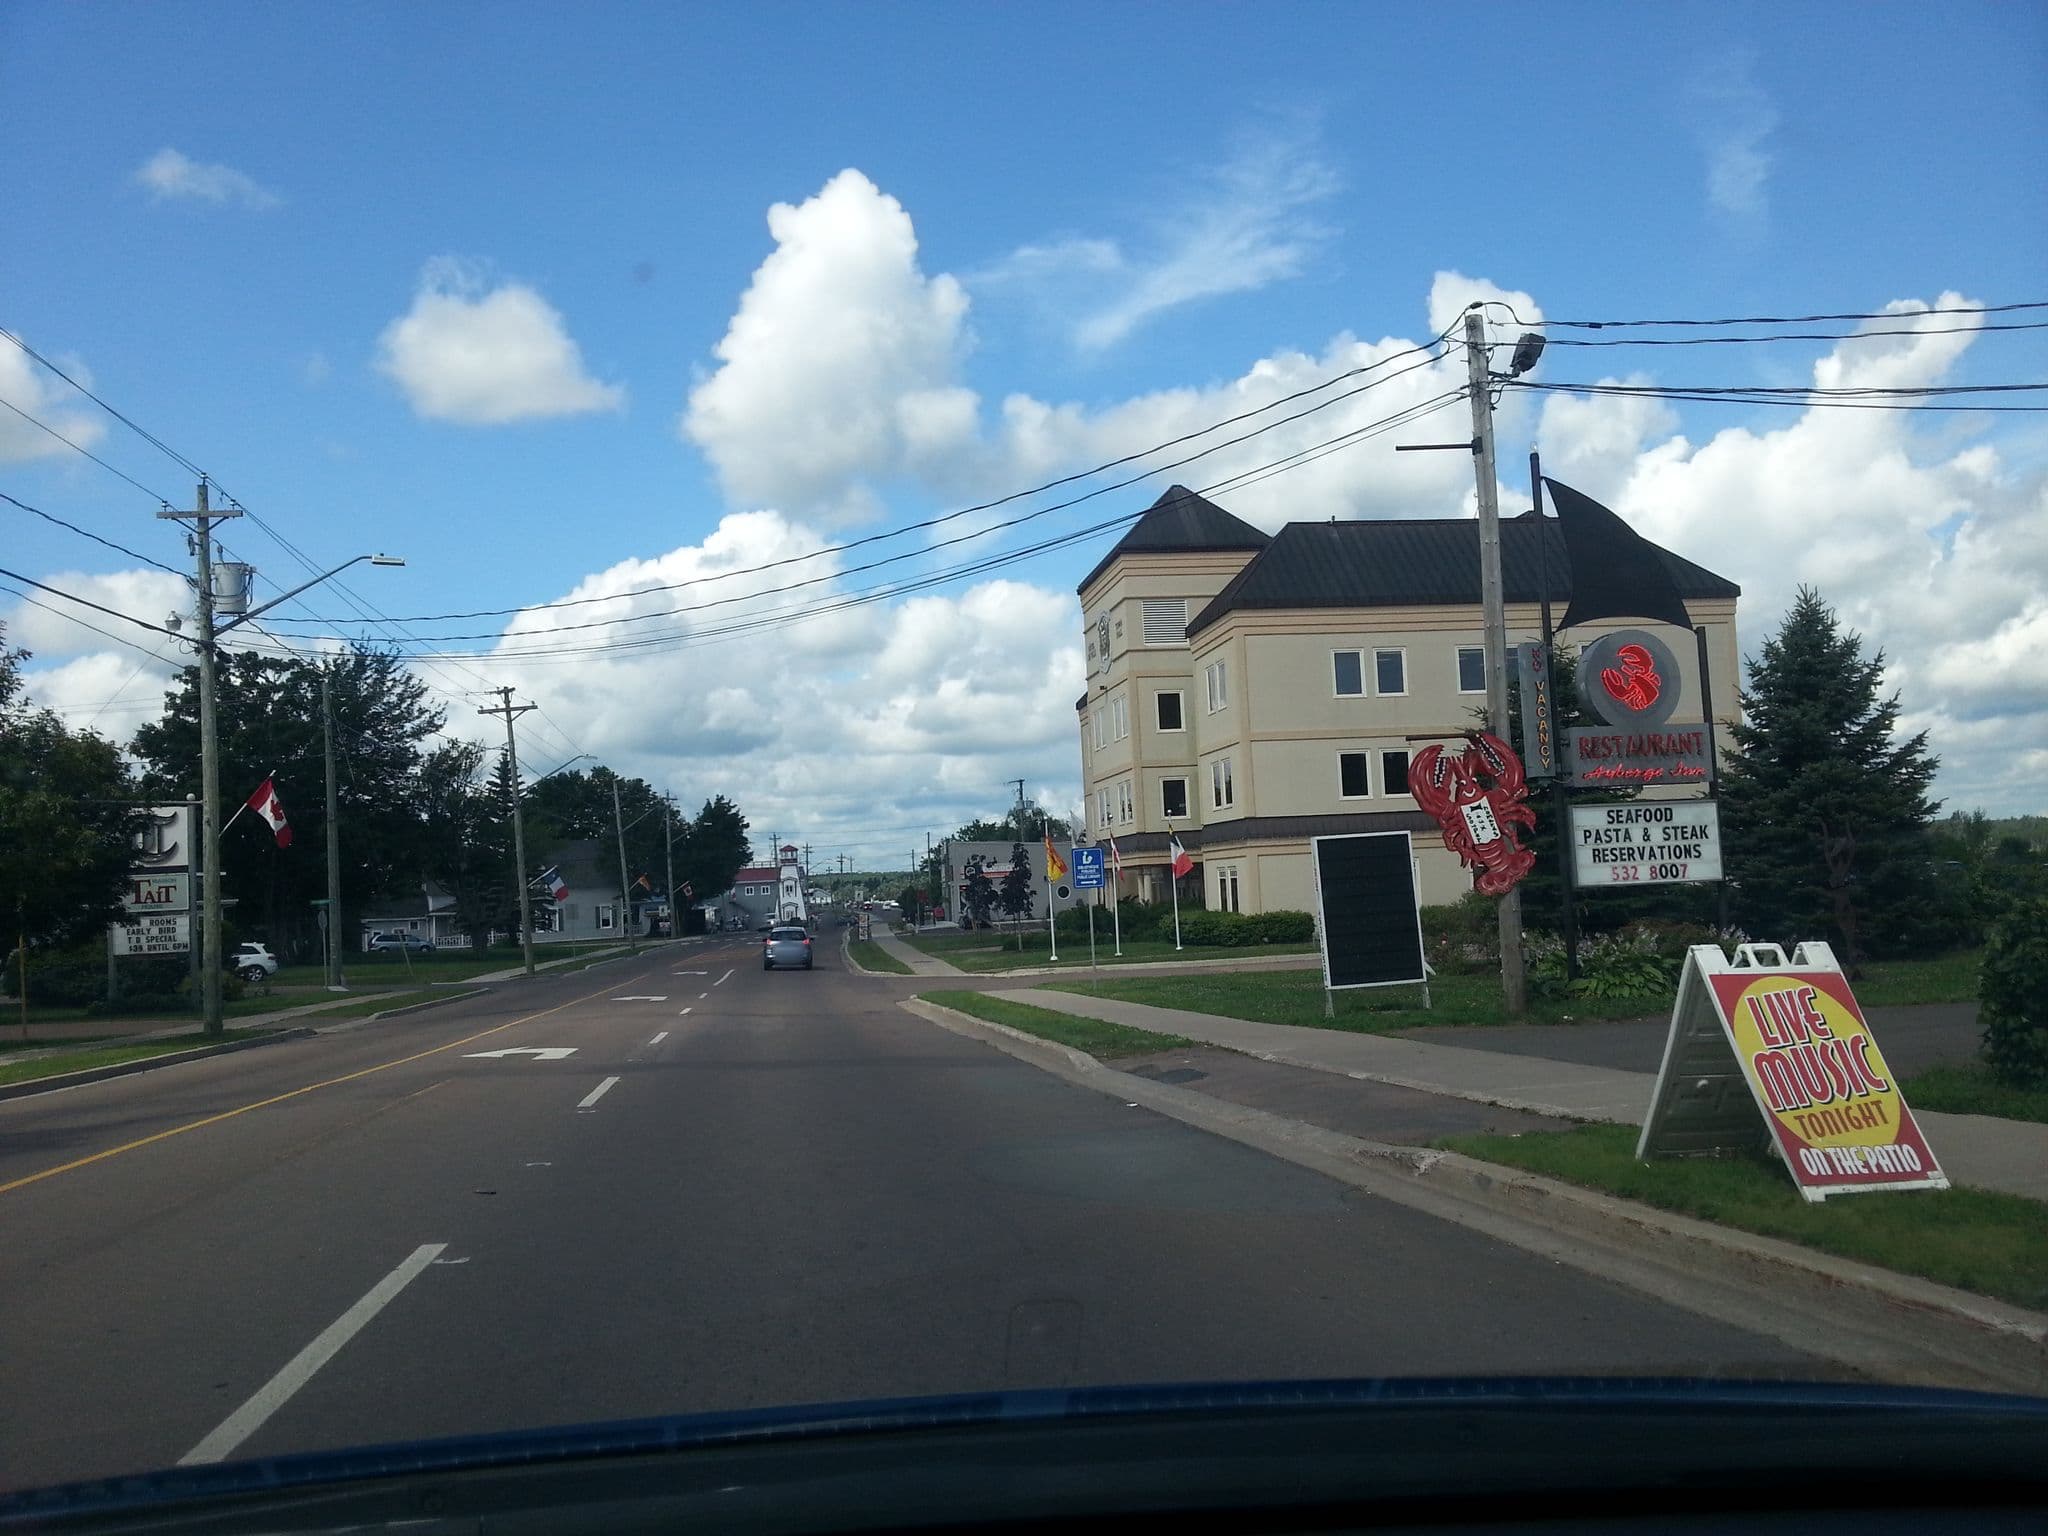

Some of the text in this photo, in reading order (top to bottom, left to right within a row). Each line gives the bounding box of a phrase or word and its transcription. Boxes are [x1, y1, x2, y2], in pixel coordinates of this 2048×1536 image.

[1536, 681, 1550, 768] VACANCY
[1579, 732, 1704, 759] RESTAURANT
[1607, 807, 1673, 824] SEAFOOD
[1583, 825, 1709, 844] PASTA & STEAK
[1592, 844, 1702, 863] RESERVATIONS
[1612, 864, 1688, 881] 532 8007
[150, 918, 177, 926] ROOMS
[146, 935, 177, 943] SPECIAL
[1745, 986, 1832, 1048] LIVE
[1753, 1034, 1889, 1112] MUSIC
[1793, 1100, 1889, 1140] TONIGHT
[1799, 1143, 1922, 1176] ON THE PATIO
